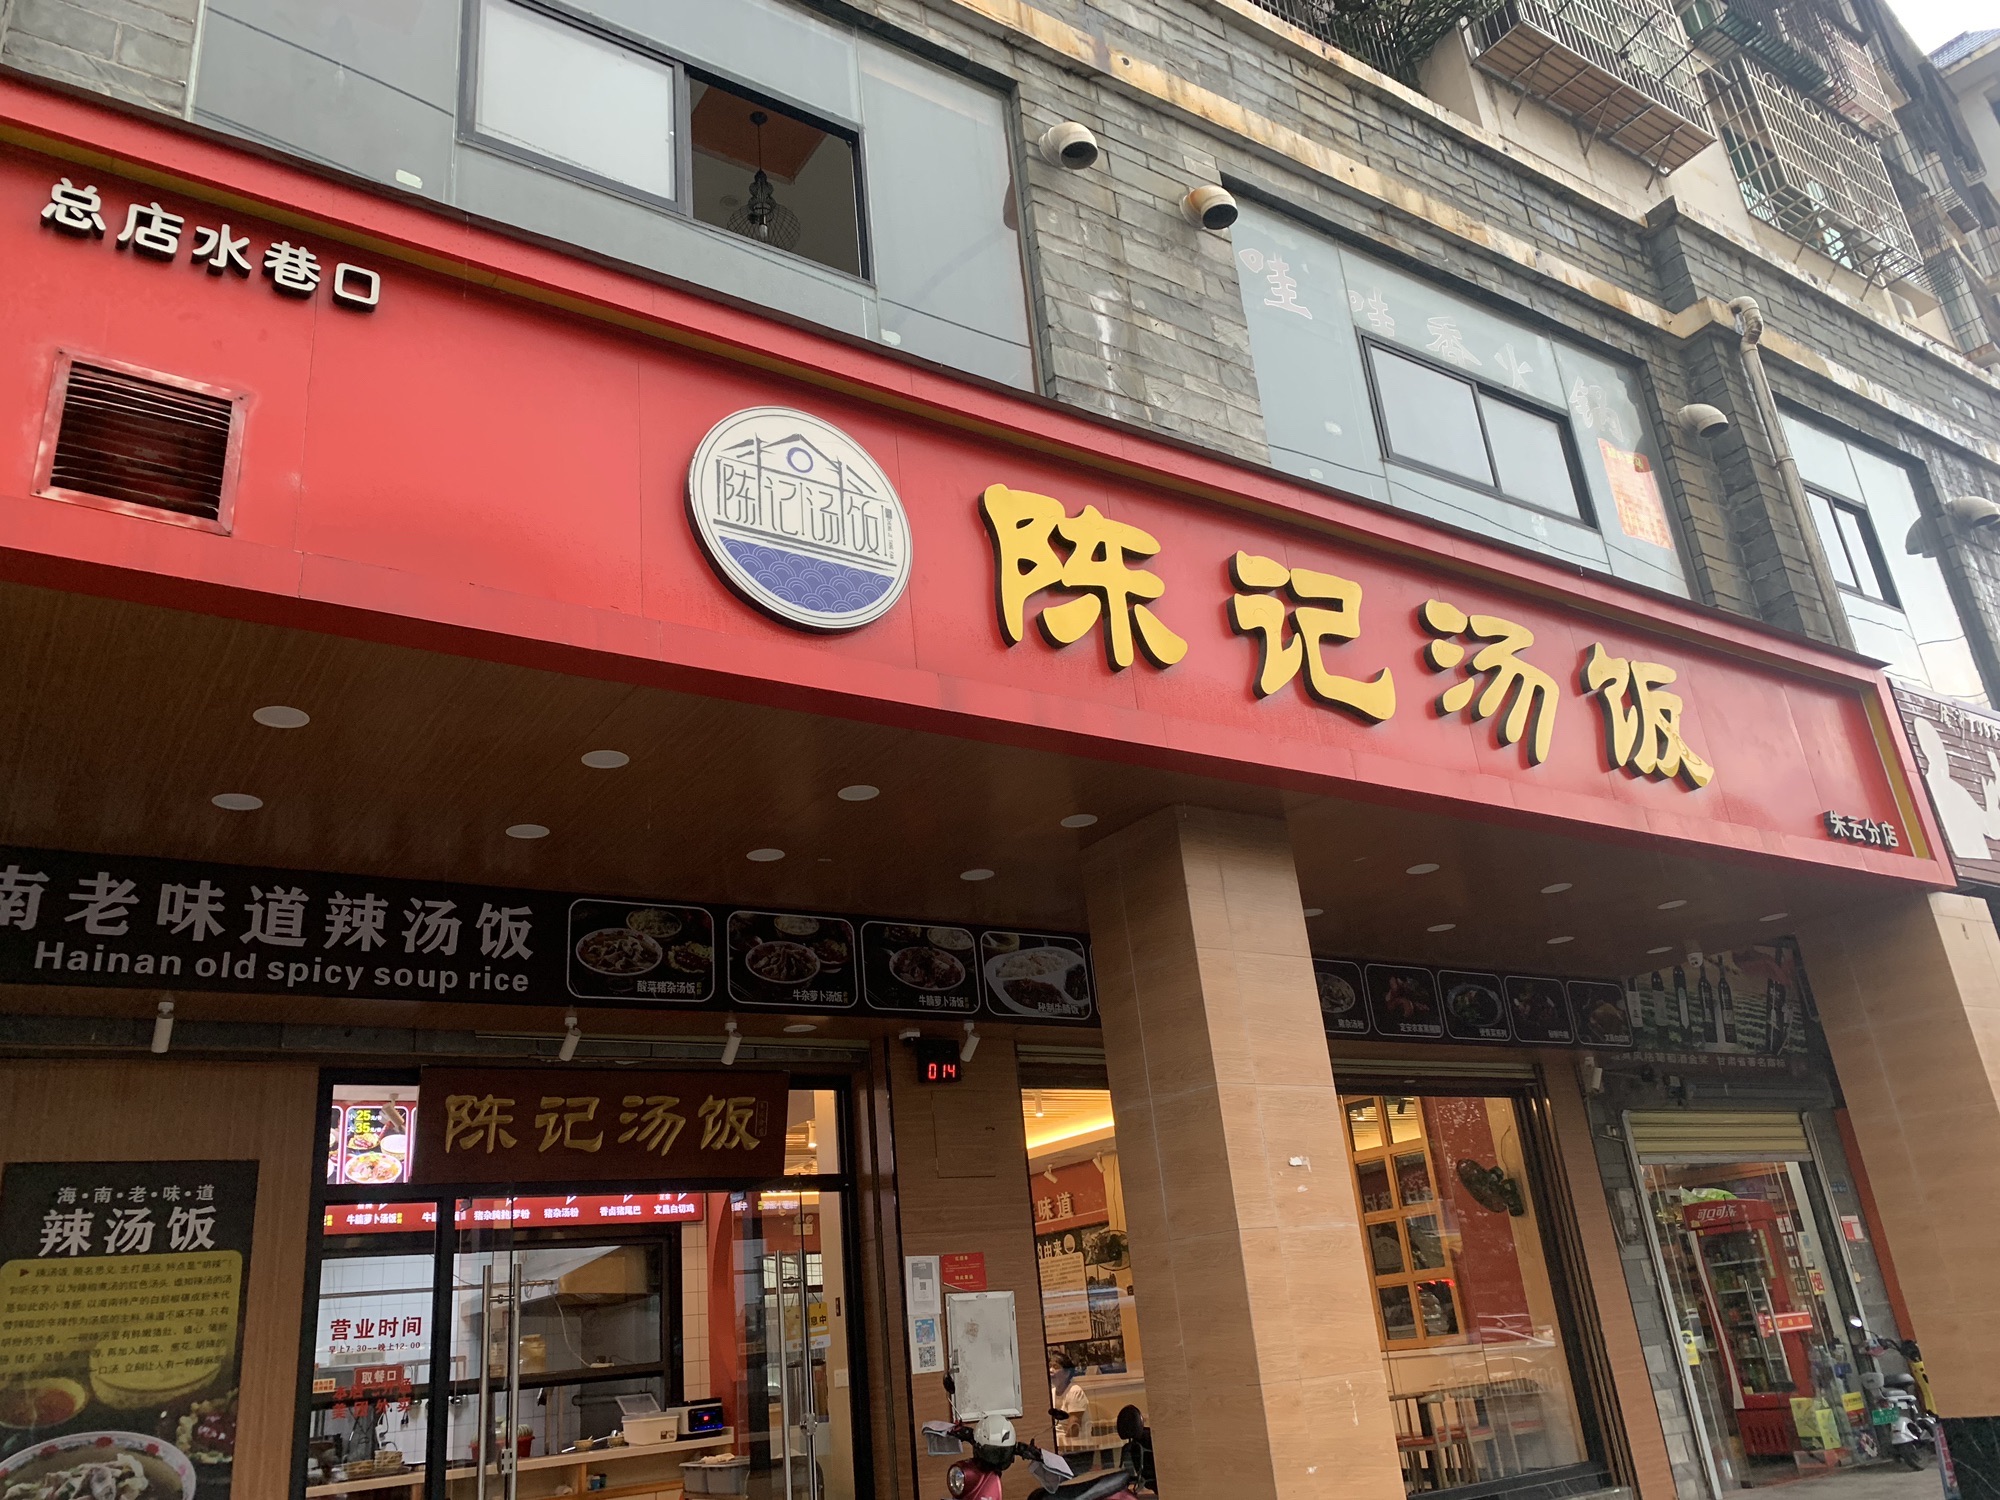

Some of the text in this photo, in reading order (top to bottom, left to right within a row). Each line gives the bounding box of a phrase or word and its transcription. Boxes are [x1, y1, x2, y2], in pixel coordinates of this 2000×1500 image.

[42, 178, 381, 306] 总店水巷口
[983, 483, 1715, 789] 陈记汤饭
[1826, 810, 1900, 848] 朱云分店
[0, 865, 535, 961] 南老味道辣汤饭
[34, 941, 530, 996] Hainan old spicy soup rice
[792, 988, 843, 1003] 牛杂萝卜汤饭
[927, 1063, 956, 1080] 014
[444, 1092, 761, 1157] 陈记汤饭
[1037, 1192, 1074, 1221] 味道
[38, 1205, 218, 1258] 辣汤饭
[330, 1316, 422, 1341] 营业时间
[361, 1370, 397, 1385] 取餐口
